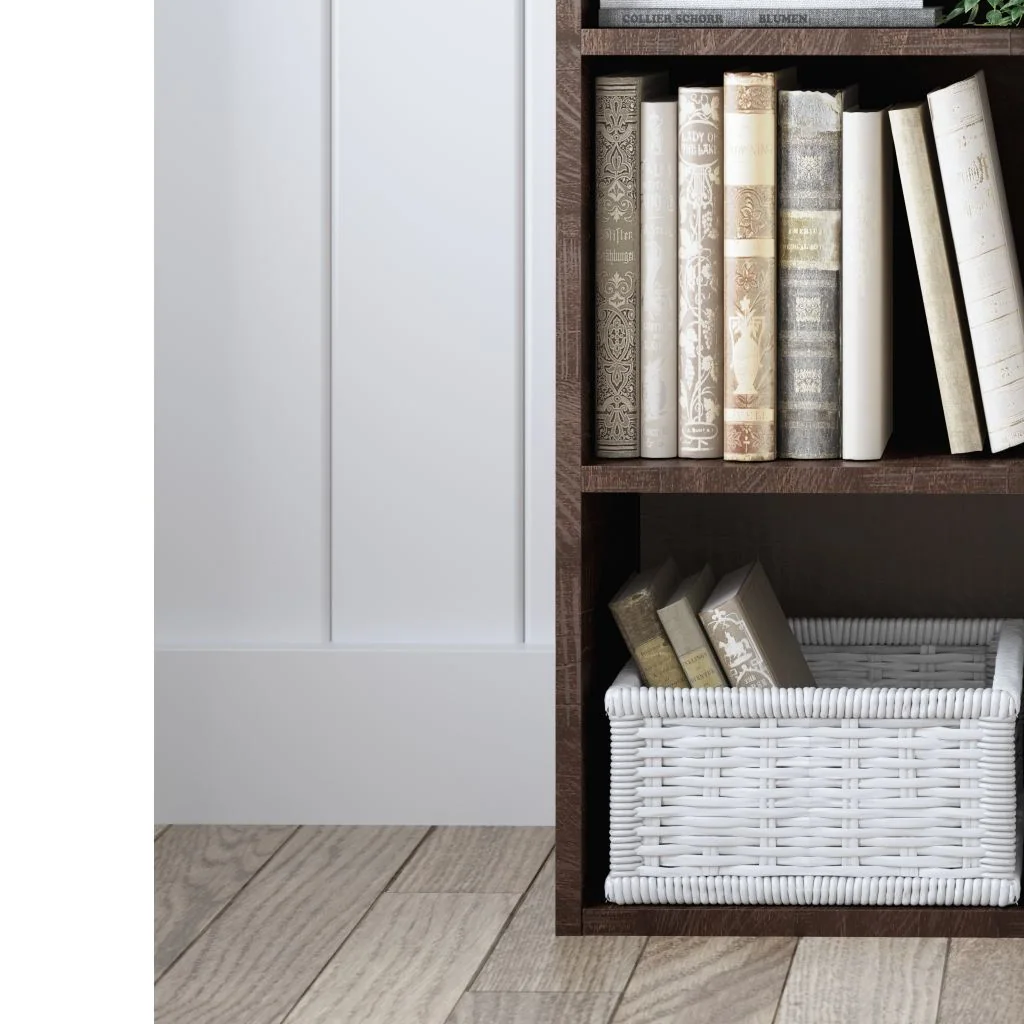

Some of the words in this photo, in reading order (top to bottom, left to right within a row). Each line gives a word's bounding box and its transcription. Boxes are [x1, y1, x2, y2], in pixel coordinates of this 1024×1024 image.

[622, 13, 672, 24] COLLIER
[675, 13, 724, 24] SCHORR
[758, 13, 808, 24] BLUMEN
